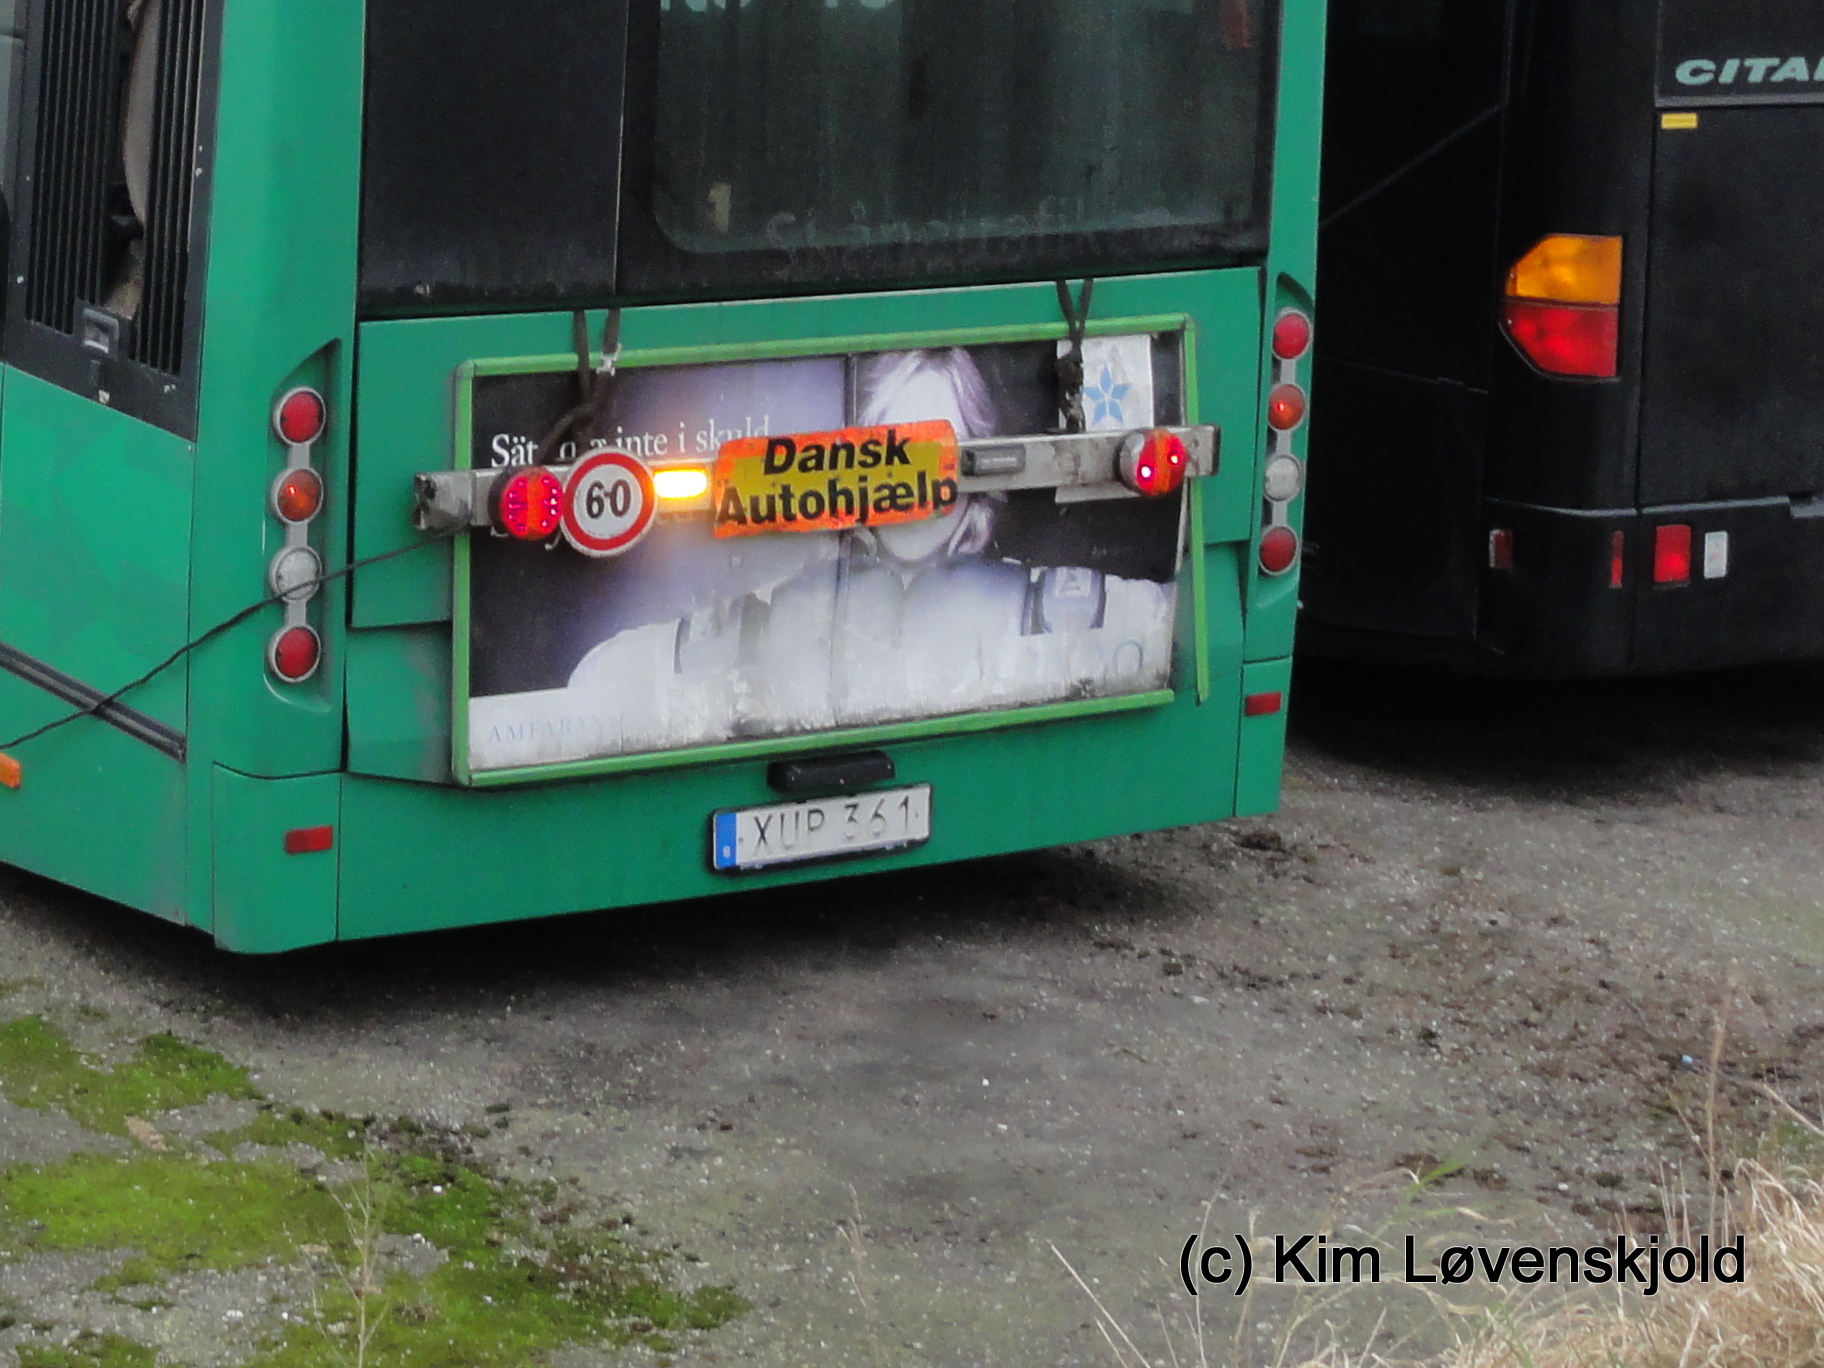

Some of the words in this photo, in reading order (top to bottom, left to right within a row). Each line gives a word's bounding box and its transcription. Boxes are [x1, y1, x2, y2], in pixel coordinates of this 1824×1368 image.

[616, 425, 668, 456] inte
[763, 429, 911, 476] Dansk
[585, 478, 632, 520] 60
[717, 470, 959, 525] Autohjælp
[752, 808, 825, 857] XUP
[843, 794, 910, 842] 361
